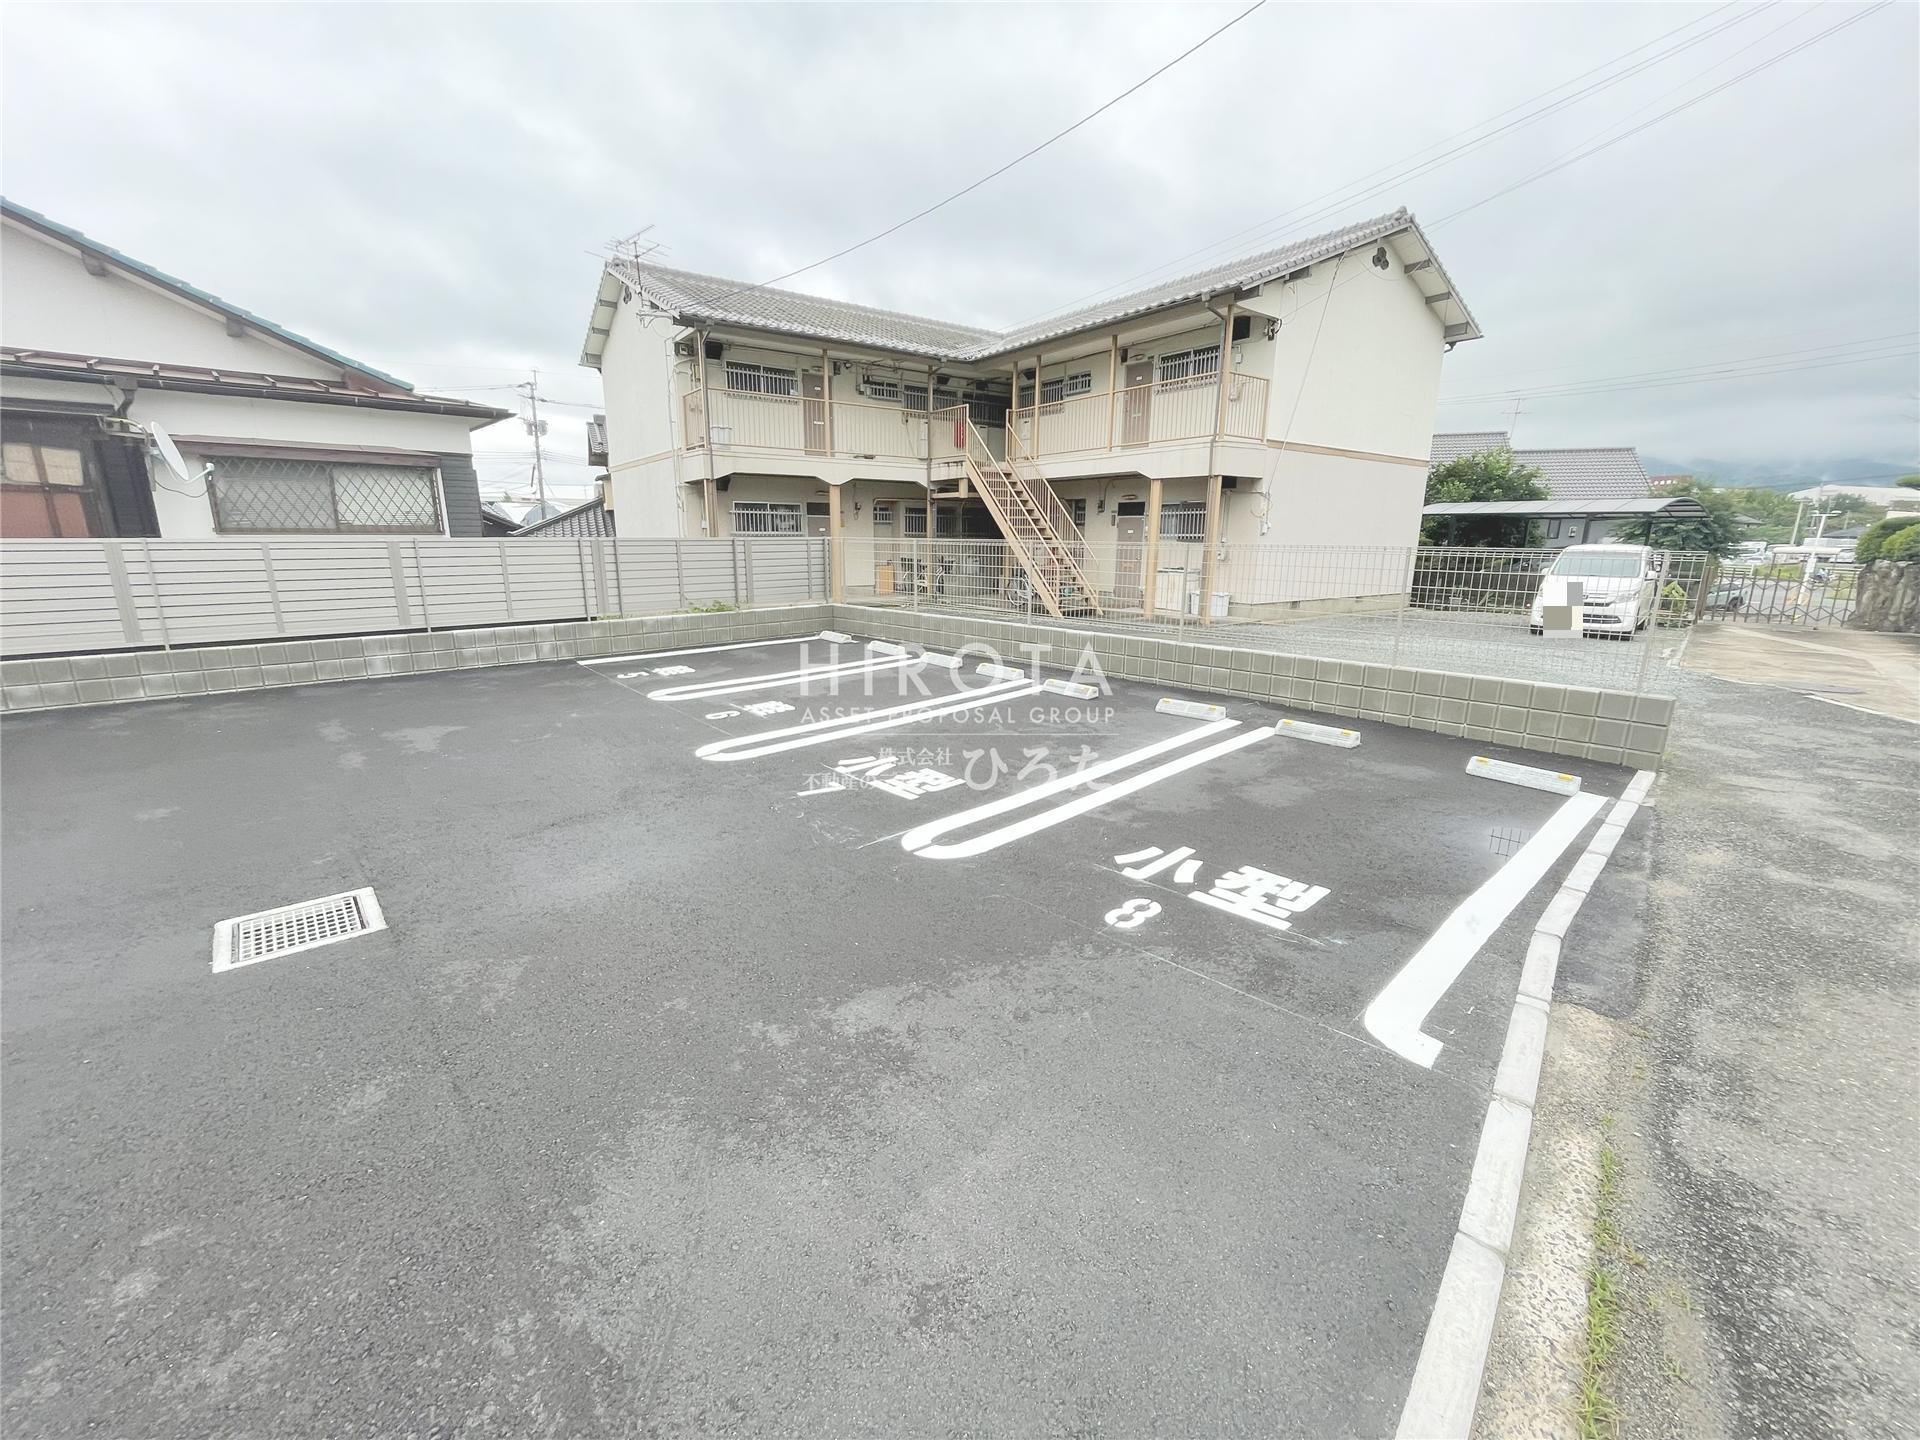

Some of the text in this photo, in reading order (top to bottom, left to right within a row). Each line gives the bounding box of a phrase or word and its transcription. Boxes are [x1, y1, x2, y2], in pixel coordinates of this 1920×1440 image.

[617, 671, 649, 679] 5
[1113, 846, 1332, 930] 小型
[1104, 898, 1162, 928] 8
